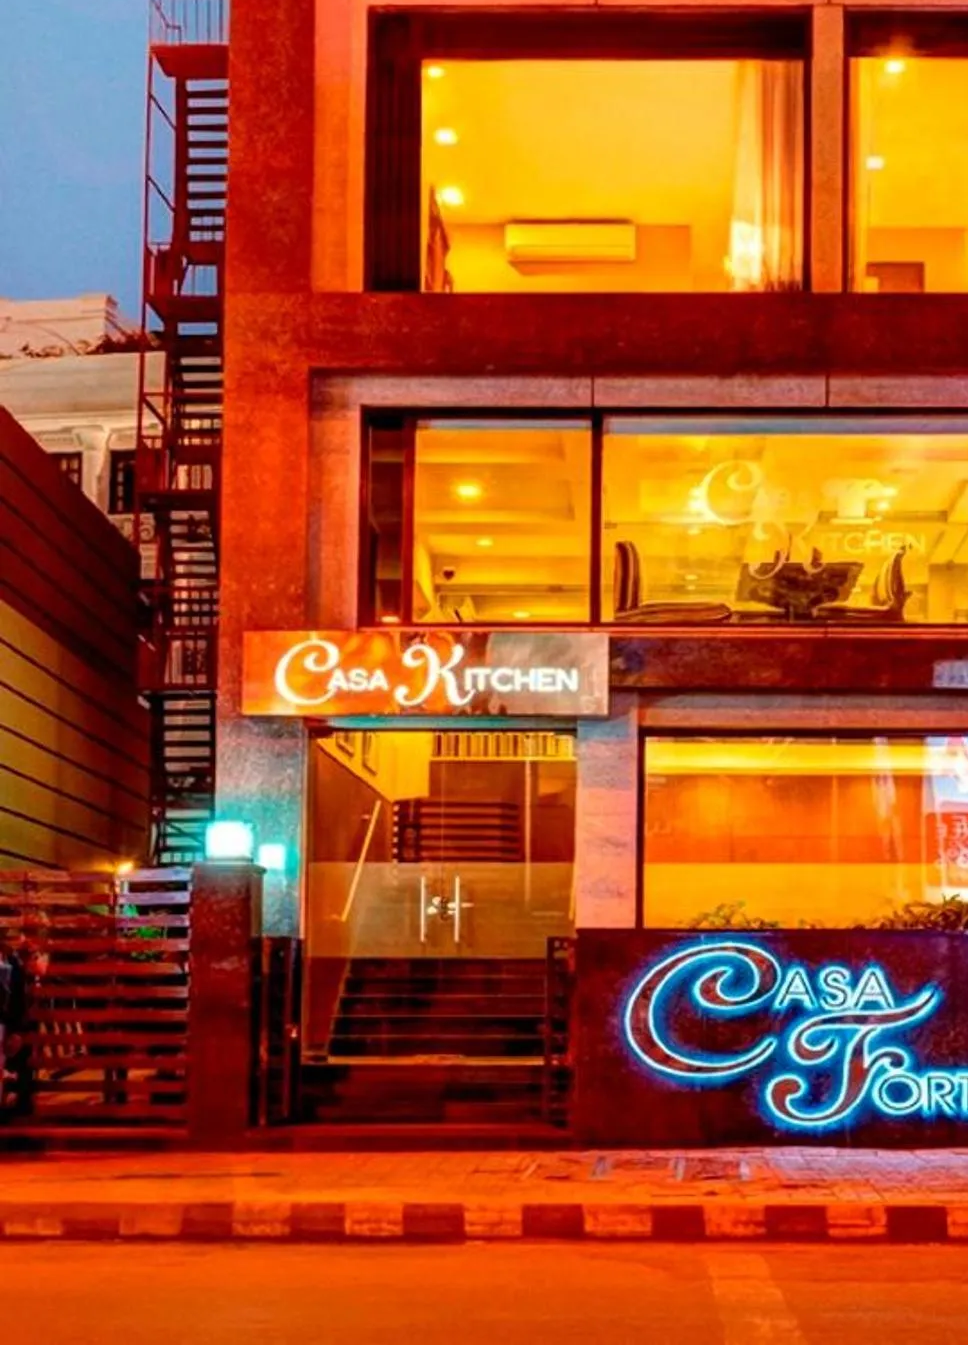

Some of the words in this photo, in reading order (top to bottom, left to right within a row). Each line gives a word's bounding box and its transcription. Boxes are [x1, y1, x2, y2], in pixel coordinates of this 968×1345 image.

[275, 639, 388, 705] CASA
[394, 643, 578, 706] KITCHEN
[626, 941, 895, 1075] CASA
